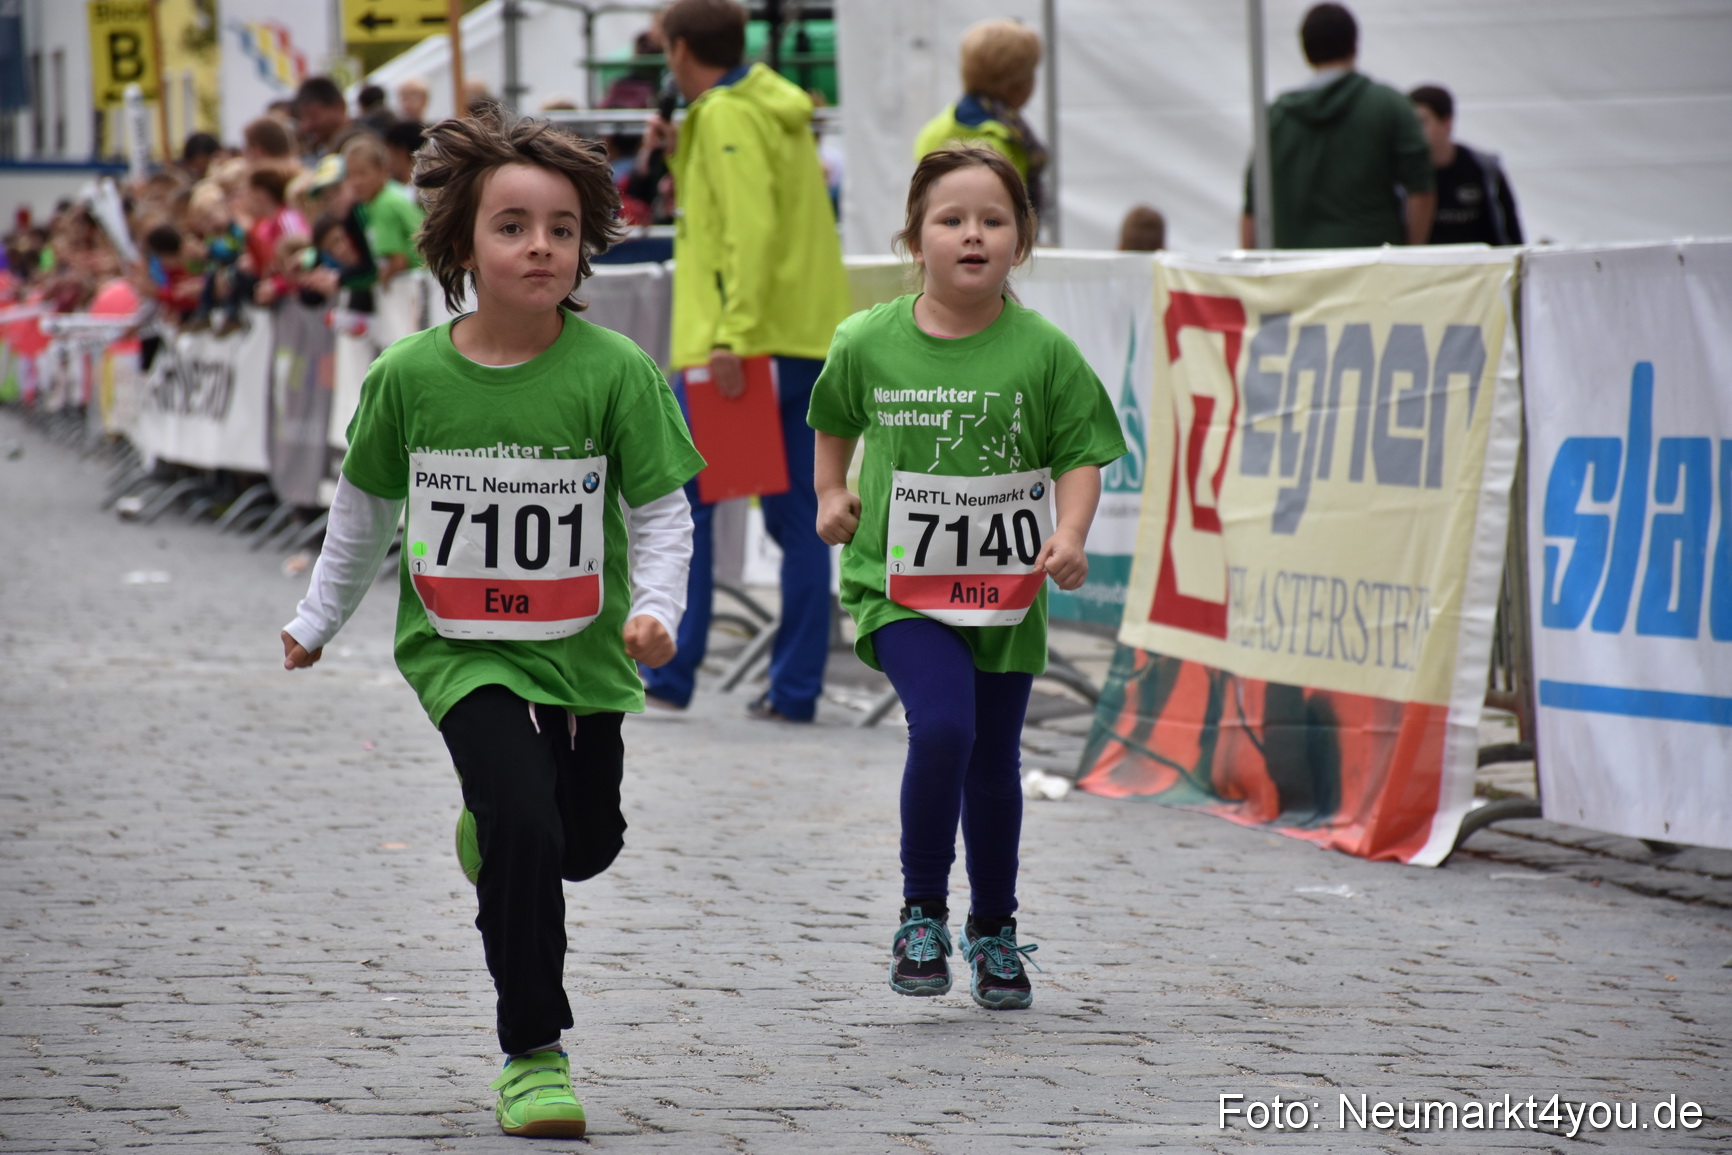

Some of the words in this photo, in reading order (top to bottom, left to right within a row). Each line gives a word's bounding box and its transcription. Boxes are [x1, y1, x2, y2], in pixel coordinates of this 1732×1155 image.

[109, 31, 145, 82] B
[874, 387, 977, 403] Neumarkter
[877, 410, 953, 430] Stadtlauf
[415, 472, 477, 492] PARTL
[483, 477, 576, 495] Neumarkt
[895, 487, 951, 505] PARTL
[955, 488, 1025, 506] Neumarkt
[431, 501, 583, 571] 7101
[908, 509, 1042, 567] 7140
[415, 561, 421, 572] 1
[587, 560, 594, 572] K
[895, 563, 900, 572] 1
[485, 588, 529, 614] Eva
[949, 582, 999, 608] Anja
